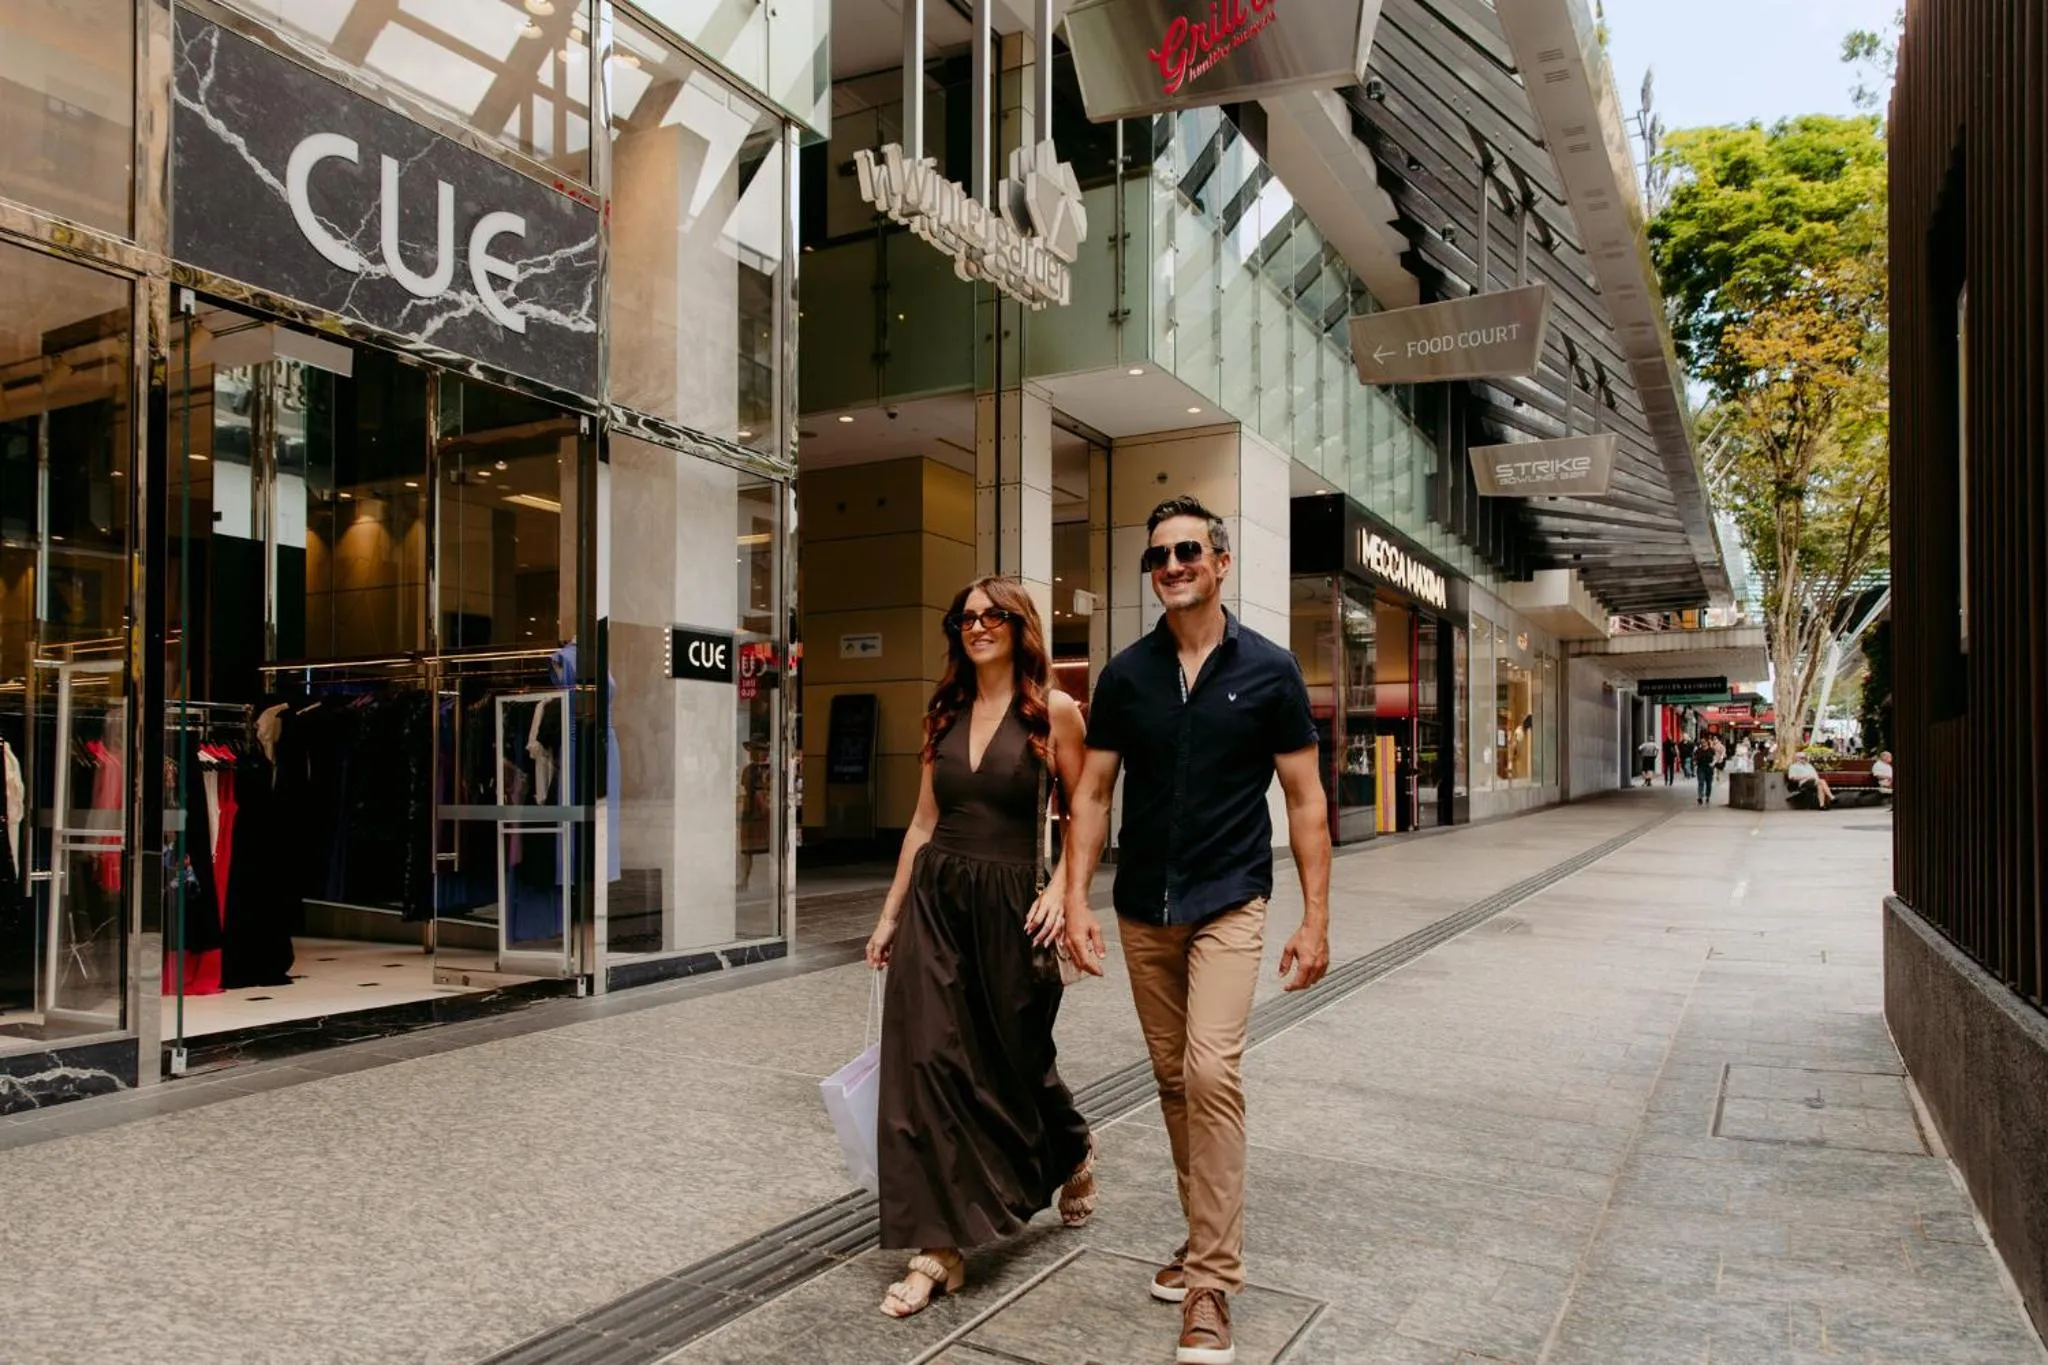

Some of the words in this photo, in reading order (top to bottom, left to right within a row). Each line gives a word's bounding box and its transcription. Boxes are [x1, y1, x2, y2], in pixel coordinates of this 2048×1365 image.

[286, 132, 527, 334] CUE
[1406, 335, 1454, 359] FOOD
[1457, 323, 1521, 349] COURT
[1495, 456, 1592, 478] STRIKE
[1358, 527, 1406, 589] MECCA
[1407, 555, 1447, 610] MAXIMA
[687, 640, 727, 670] CUE
